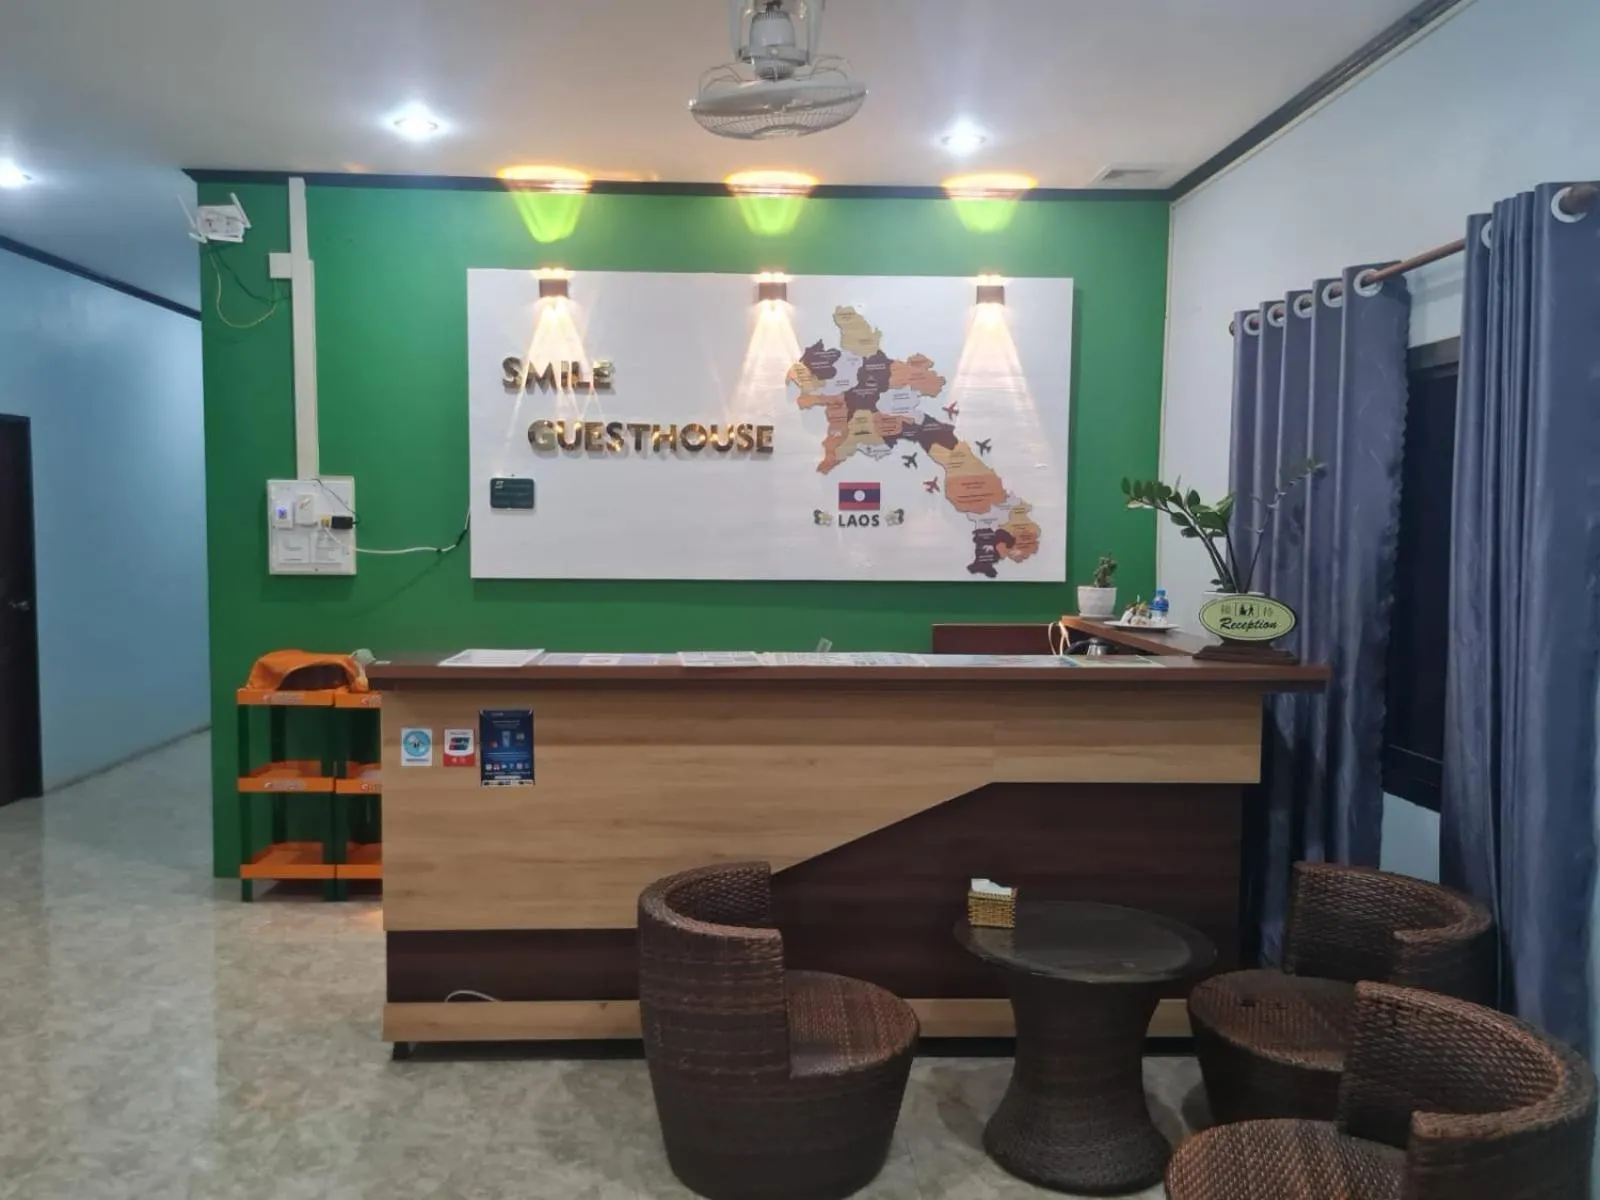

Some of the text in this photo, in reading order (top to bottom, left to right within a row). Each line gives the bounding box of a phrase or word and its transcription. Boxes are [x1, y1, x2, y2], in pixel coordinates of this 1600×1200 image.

[502, 356, 614, 389] SMILE
[528, 419, 774, 453] GUESTHOUSE
[838, 514, 880, 527] LAOS
[1220, 618, 1277, 632] Reception
